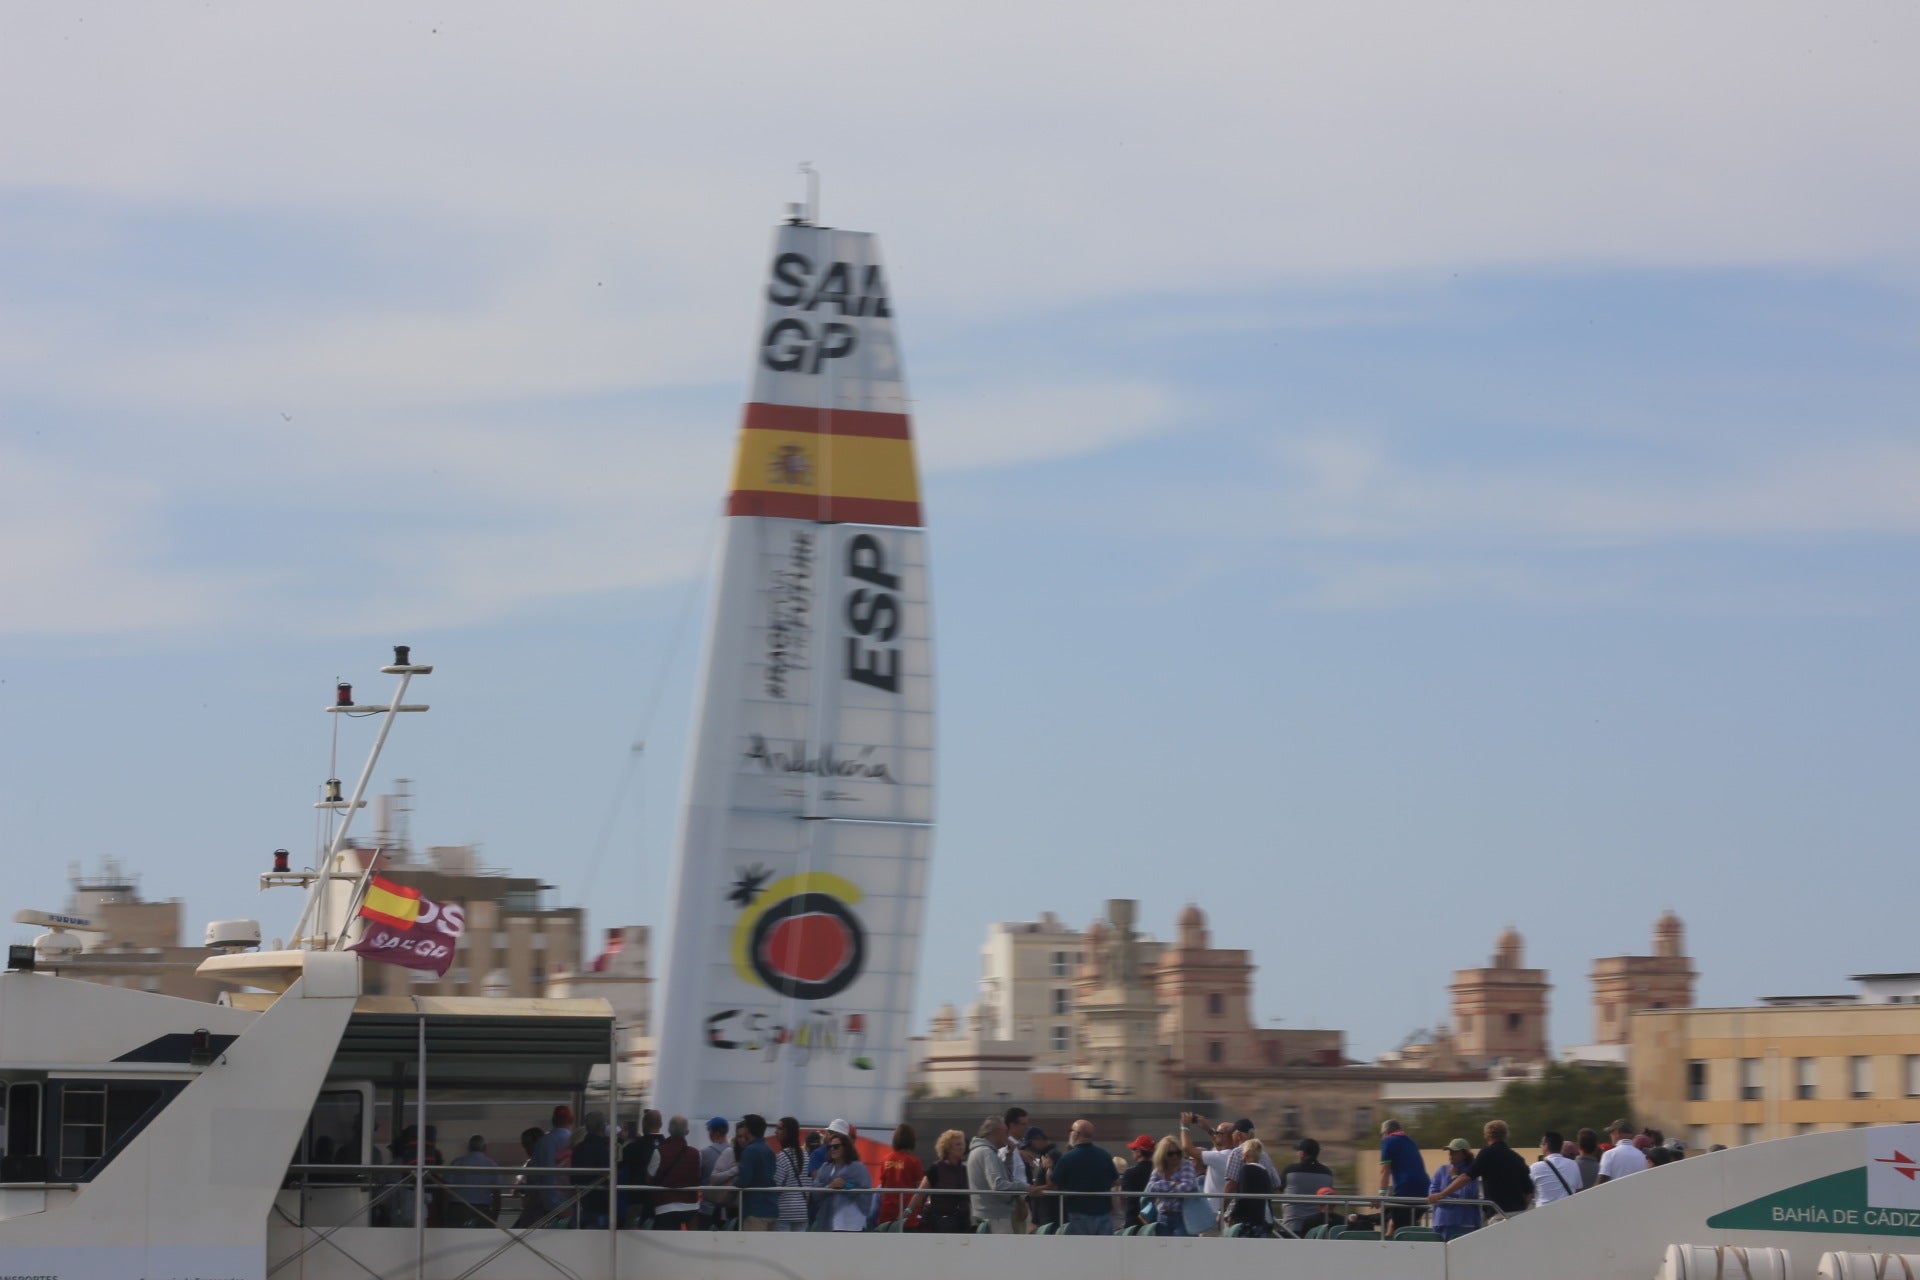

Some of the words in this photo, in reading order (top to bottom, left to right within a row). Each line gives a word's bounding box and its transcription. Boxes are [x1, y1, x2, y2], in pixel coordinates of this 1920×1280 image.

[762, 318, 856, 375] GP
[846, 533, 901, 694] ESP
[1772, 1205, 1829, 1223] BAHÍA
[1832, 1209, 1859, 1225] DE
[1864, 1208, 1920, 1228] CÁDIZ
